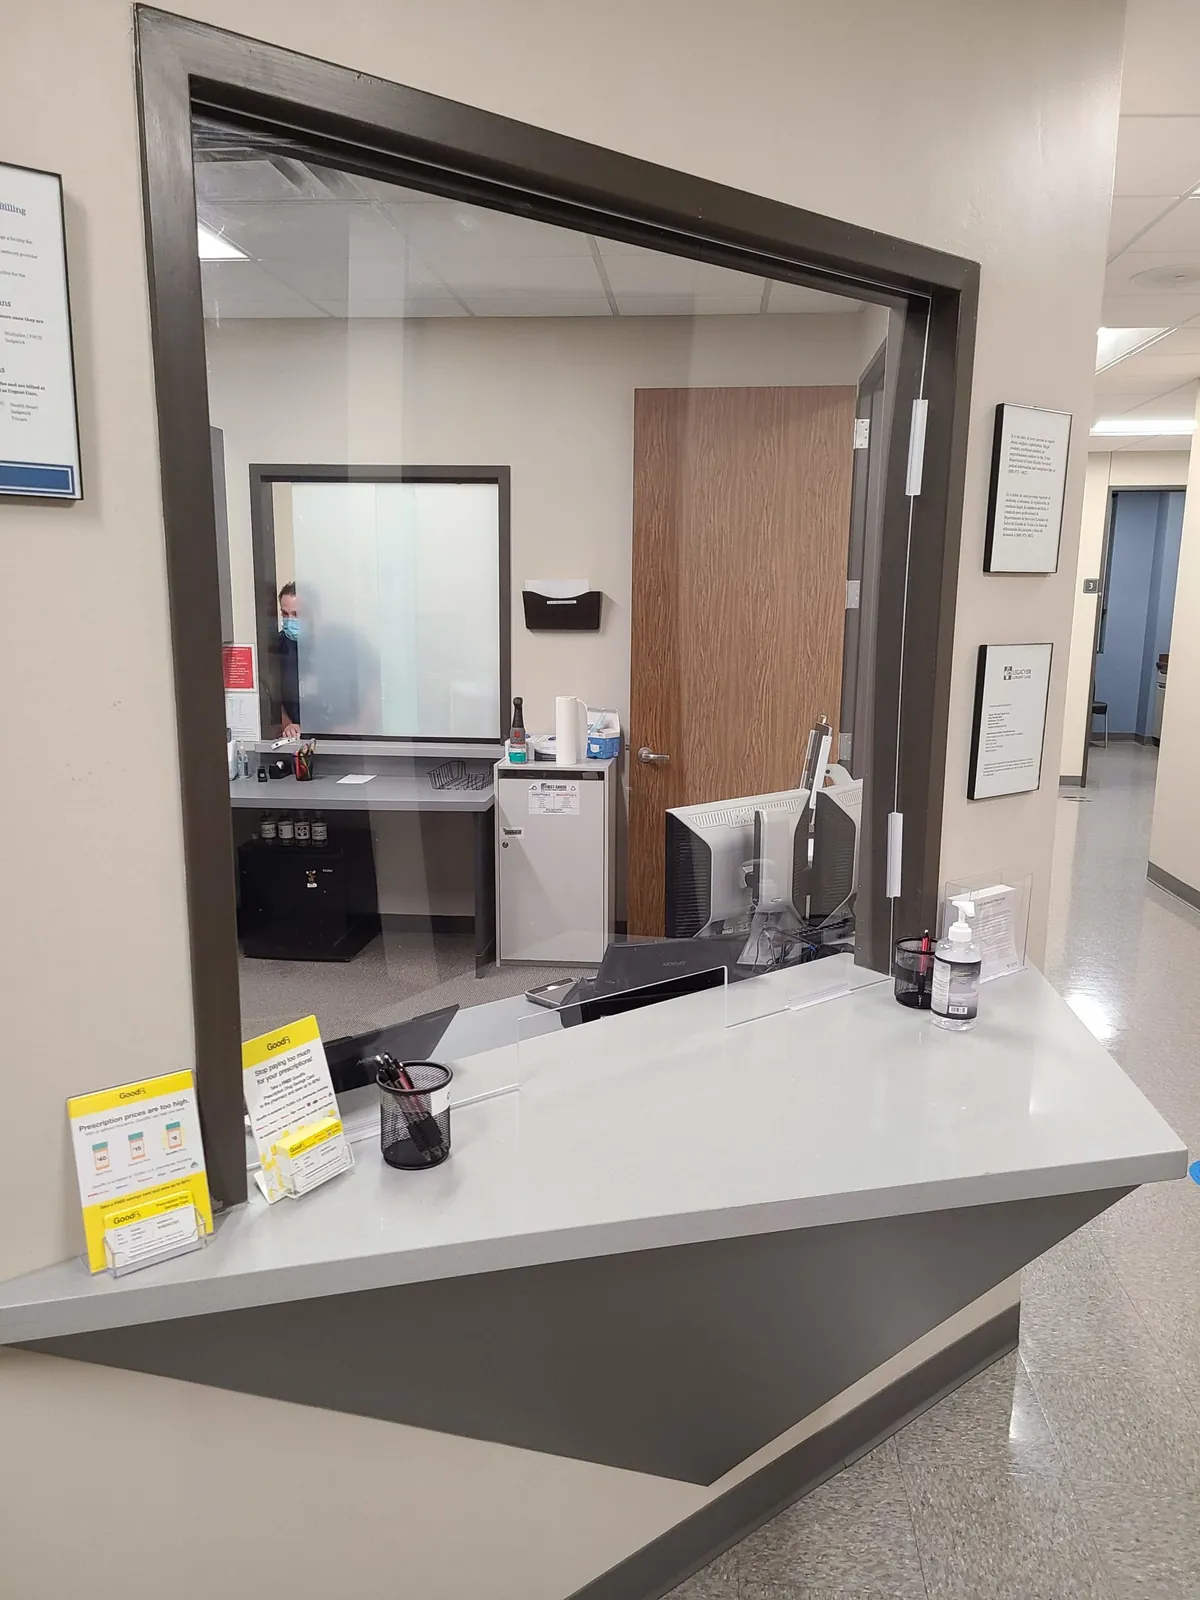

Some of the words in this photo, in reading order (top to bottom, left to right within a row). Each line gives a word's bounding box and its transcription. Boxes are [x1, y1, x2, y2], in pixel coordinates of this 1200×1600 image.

[1089, 582, 1093, 590] 3
[254, 1067, 268, 1077] Stop
[268, 1059, 287, 1072] paying
[296, 1049, 311, 1058] much
[265, 1073, 277, 1082] your
[264, 1089, 284, 1100] Prescription
[293, 1078, 307, 1086] Savings
[271, 1094, 287, 1104] pharmacy
[79, 1116, 123, 1132] Prescription
[124, 1110, 146, 1121] prices
[147, 1106, 159, 1114] are
[160, 1102, 172, 1111] too
[172, 1098, 189, 1107] high.
